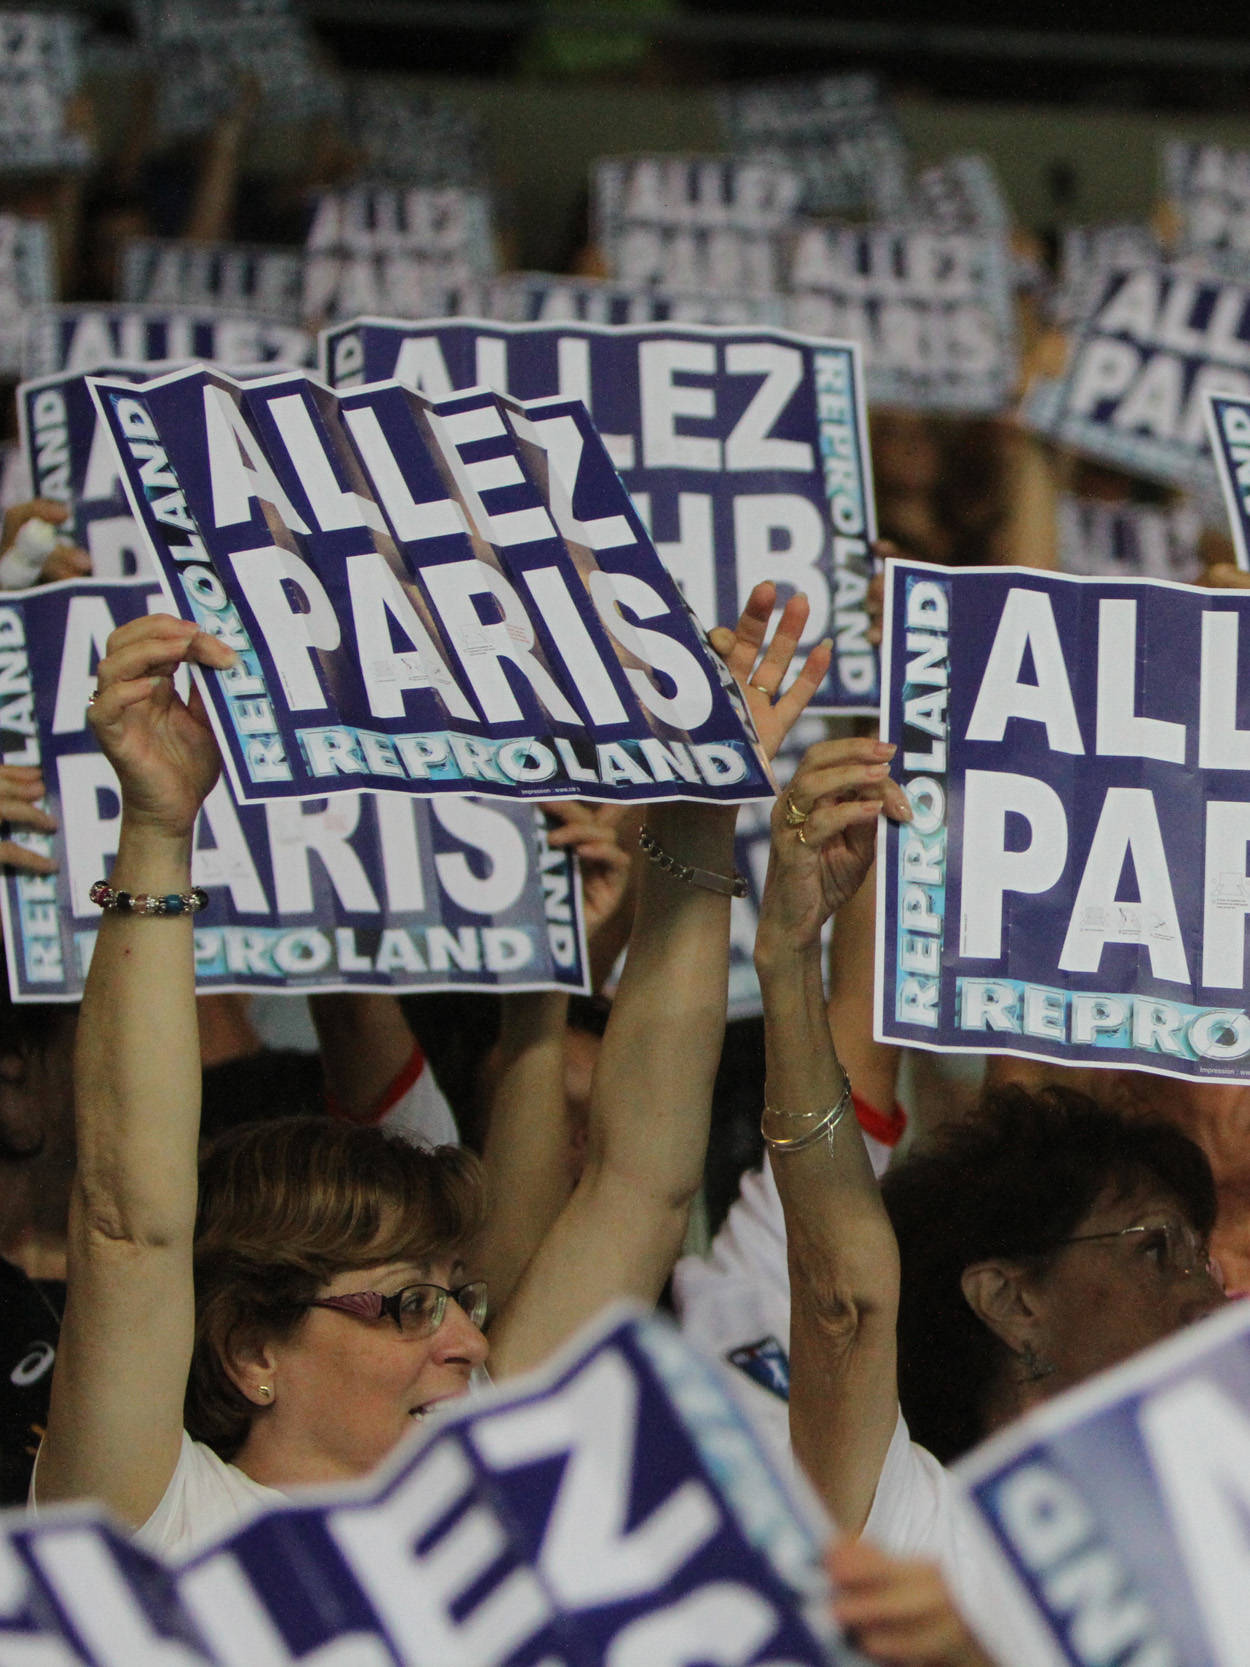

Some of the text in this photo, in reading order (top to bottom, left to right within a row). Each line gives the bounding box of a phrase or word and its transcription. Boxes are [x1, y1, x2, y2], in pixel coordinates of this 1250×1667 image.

[203, 385, 638, 550] ALLEZ
[117, 397, 293, 782] REPROLAND
[230, 546, 713, 730] PARIS
[300, 727, 749, 786] REPROLAND
[897, 577, 950, 1026] REPROLAND
[76, 926, 536, 979] PROLAND
[1199, 1066, 1235, 1075] Impression
